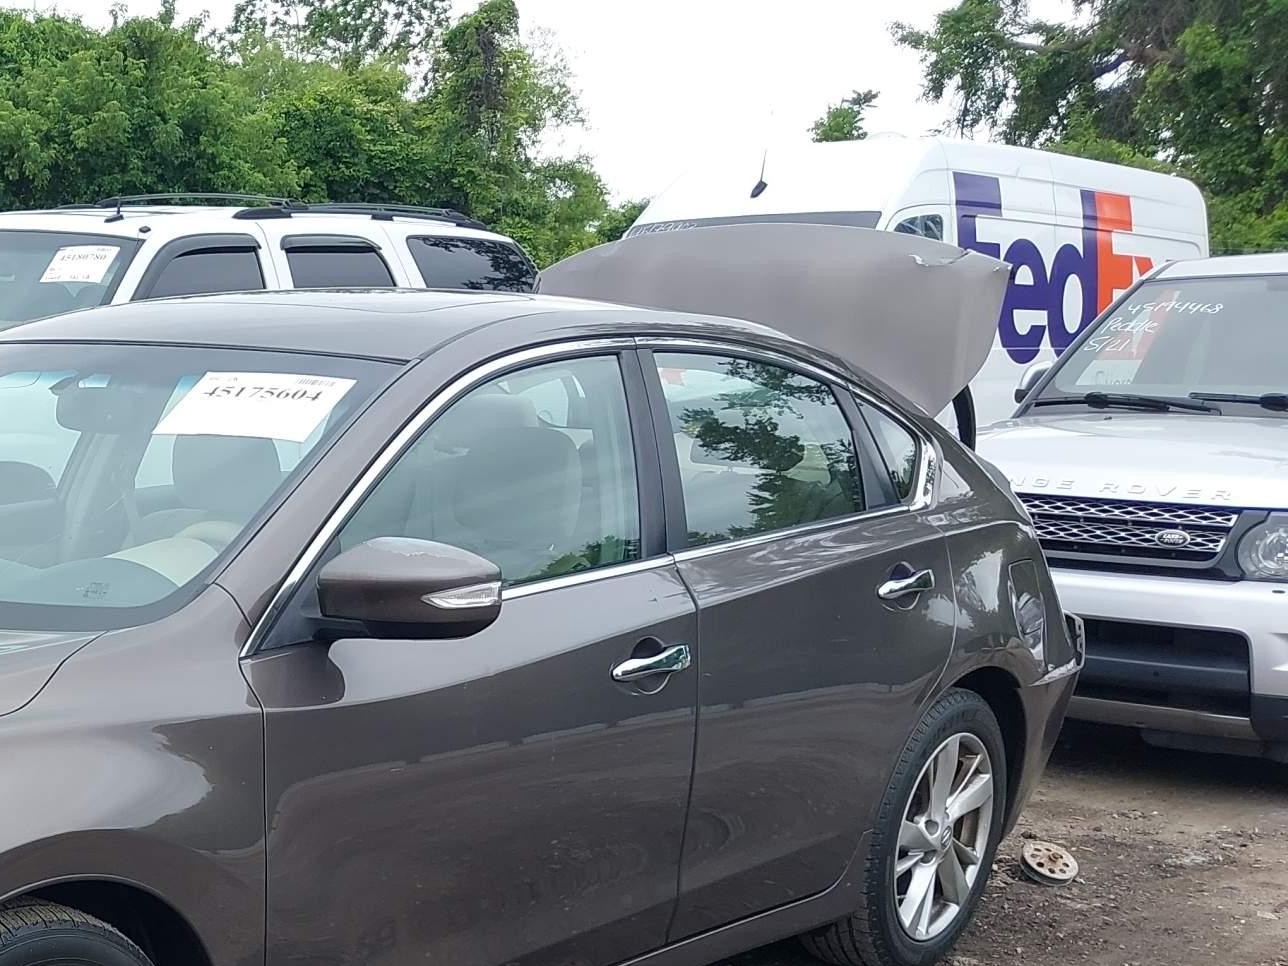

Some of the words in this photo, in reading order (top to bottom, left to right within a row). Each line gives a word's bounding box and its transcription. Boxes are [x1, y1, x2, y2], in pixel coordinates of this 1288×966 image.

[952, 171, 1155, 365] FedE
[202, 385, 323, 402] 45175604
[1011, 477, 1075, 490] NGE
[1099, 483, 1231, 501] ROVER
